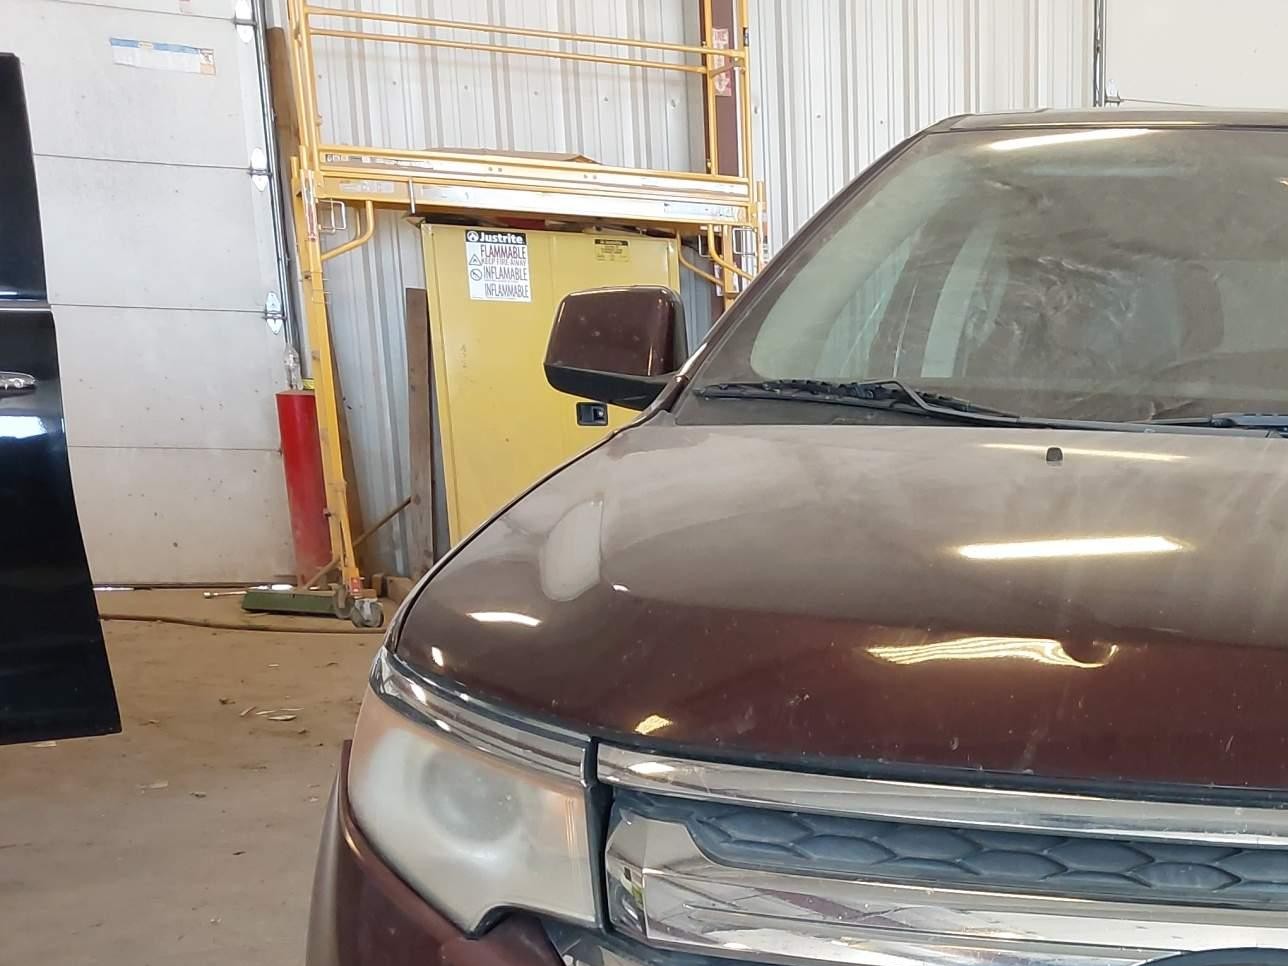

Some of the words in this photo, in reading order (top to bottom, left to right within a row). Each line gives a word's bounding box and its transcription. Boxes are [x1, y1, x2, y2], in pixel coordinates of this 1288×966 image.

[480, 231, 524, 244] Justrite
[480, 244, 527, 260] FLAMMABLE
[483, 265, 528, 281] INFLAMABLE
[484, 282, 529, 298] INFLAMMABLE
